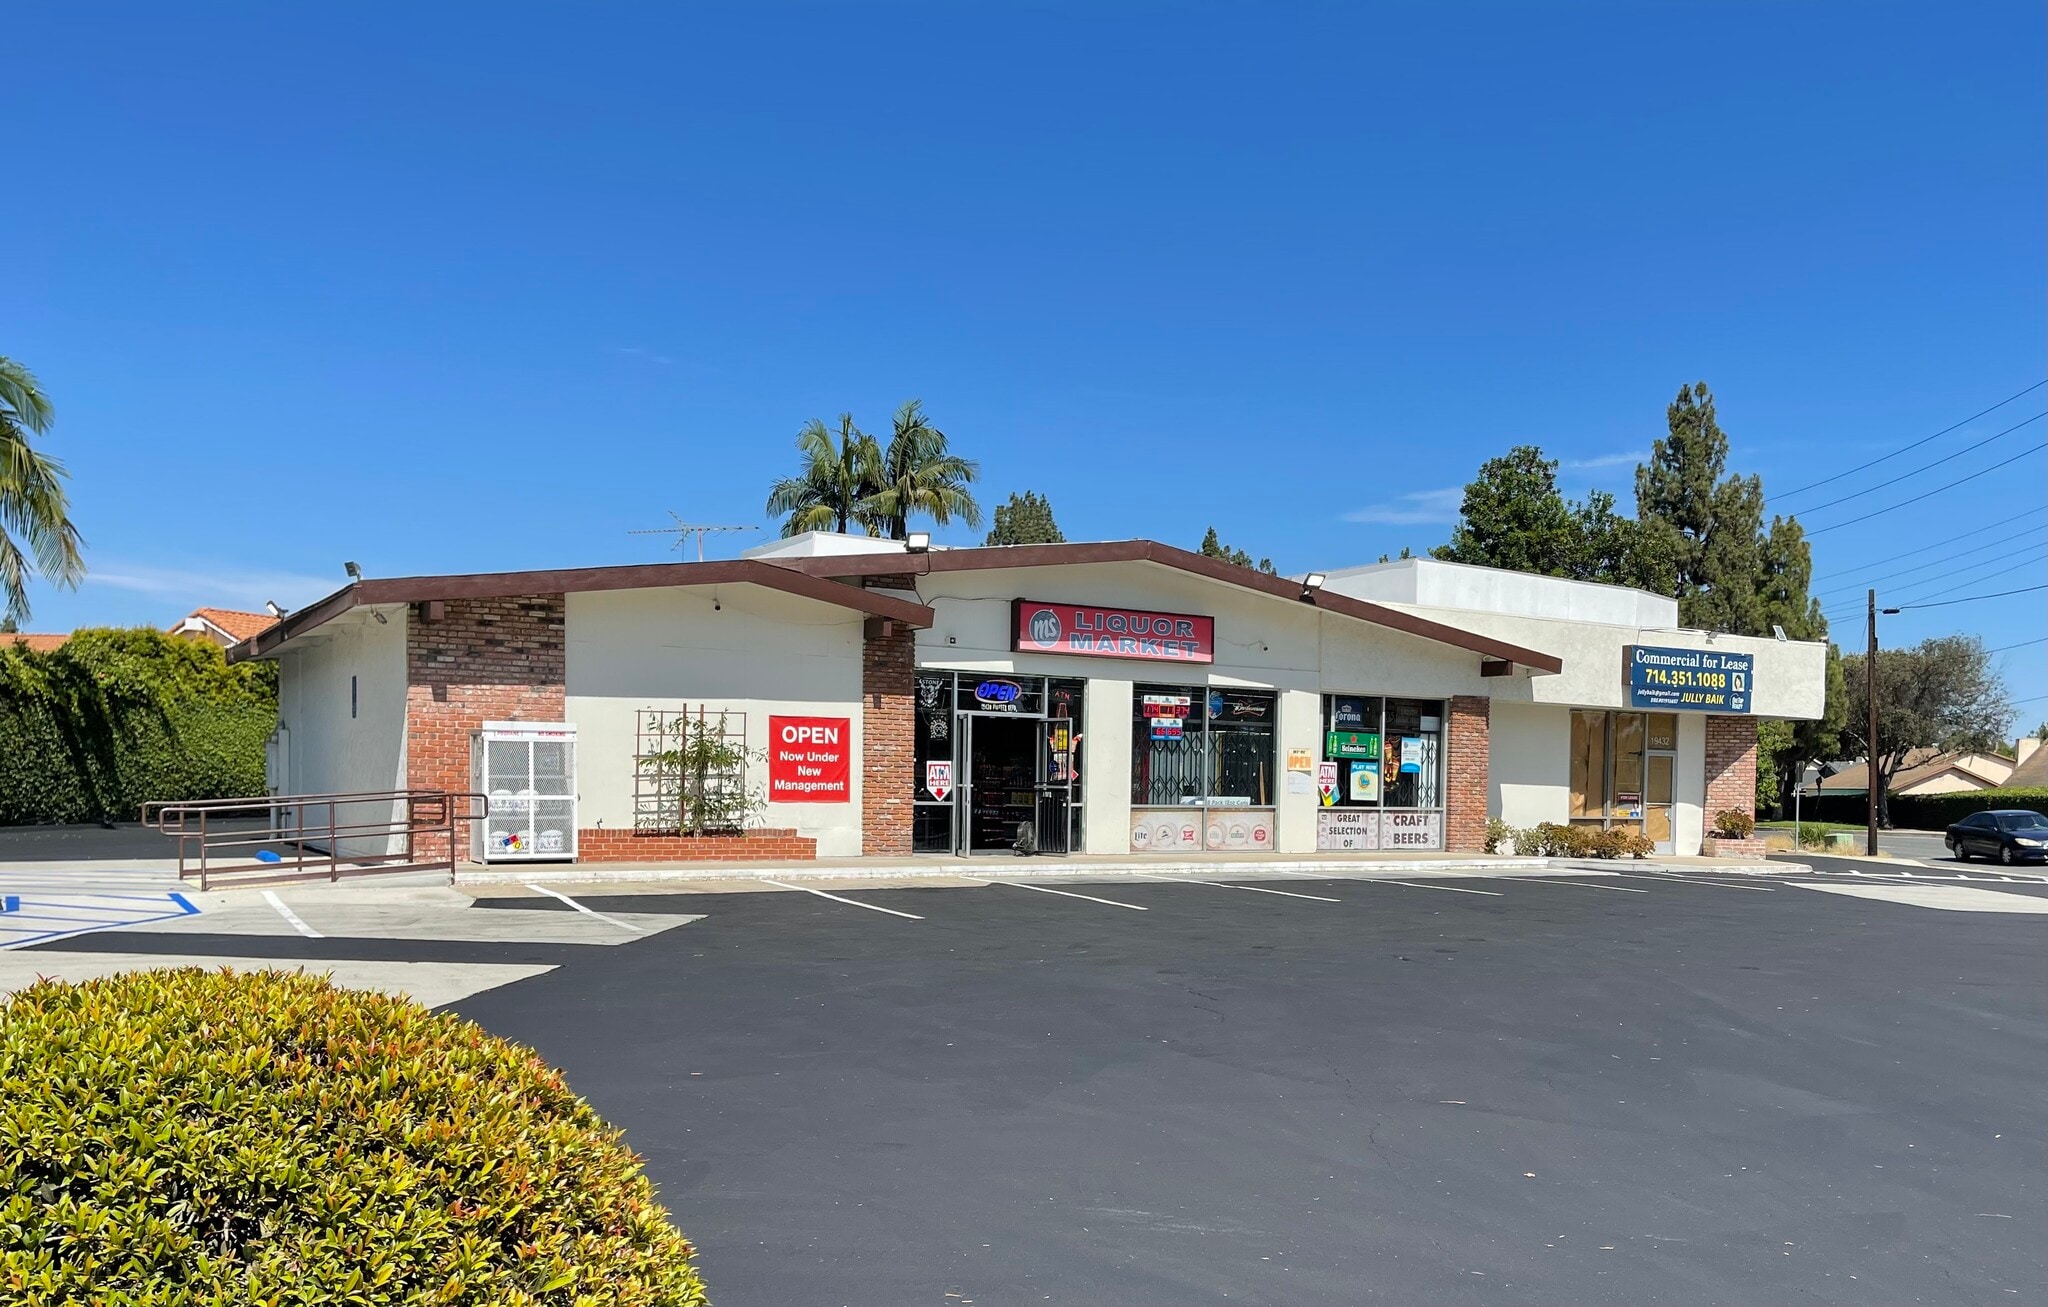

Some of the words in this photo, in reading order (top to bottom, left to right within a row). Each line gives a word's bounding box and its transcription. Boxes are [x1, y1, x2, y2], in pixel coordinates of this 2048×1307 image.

[1075, 612, 1194, 638] LIQUOR
[1069, 632, 1200, 658] MARKET
[1636, 649, 1700, 667] Commercial
[1702, 655, 1718, 668] for
[1721, 656, 1748, 671] Lease
[1645, 668, 1726, 688] 714.351.1088
[978, 682, 1018, 701] OPEN
[1054, 691, 1070, 701] ATM
[1680, 693, 1705, 704] JULLY
[1705, 694, 1725, 705] BAIK
[1335, 710, 1361, 723] Corona
[782, 726, 838, 744] OPEN
[1650, 736, 1670, 746] 19432
[1341, 744, 1366, 753] Heineken
[779, 751, 804, 761] Now
[806, 752, 839, 762] Under
[1288, 756, 1311, 768] OPEN
[797, 765, 822, 776] New
[928, 765, 950, 780] ATM
[1319, 765, 1335, 778] ATM
[774, 779, 844, 793] Management
[1337, 814, 1360, 823] GREAT
[1393, 815, 1429, 826] CRAFT
[1328, 827, 1368, 835] SELECTION
[1393, 833, 1428, 844] BEERS
